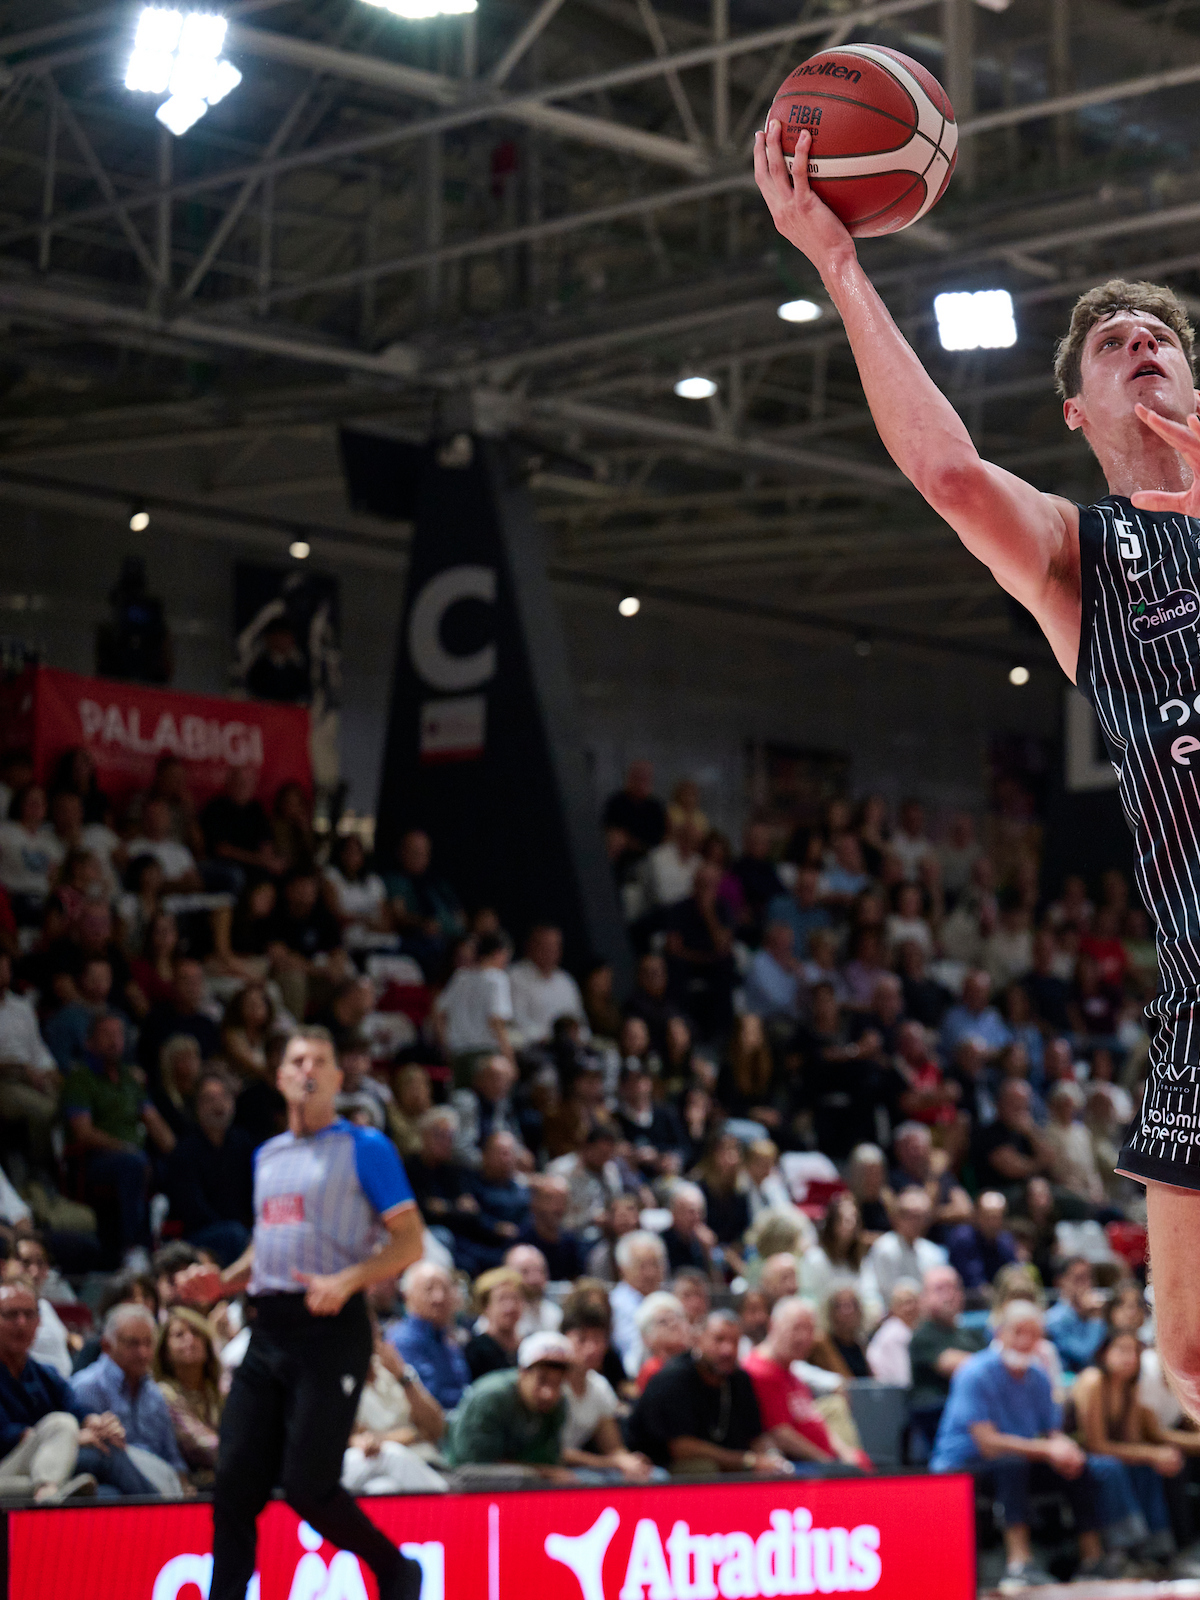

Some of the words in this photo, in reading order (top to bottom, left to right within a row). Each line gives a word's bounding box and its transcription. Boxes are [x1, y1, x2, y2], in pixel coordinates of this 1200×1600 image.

[792, 62, 862, 84] molten
[788, 105, 823, 126] FIBA
[786, 125, 819, 137] APPRED
[1114, 518, 1143, 560] 5
[409, 565, 497, 691] C
[1160, 1083, 1190, 1095] TRENTO
[618, 1506, 882, 1600] Atradius
